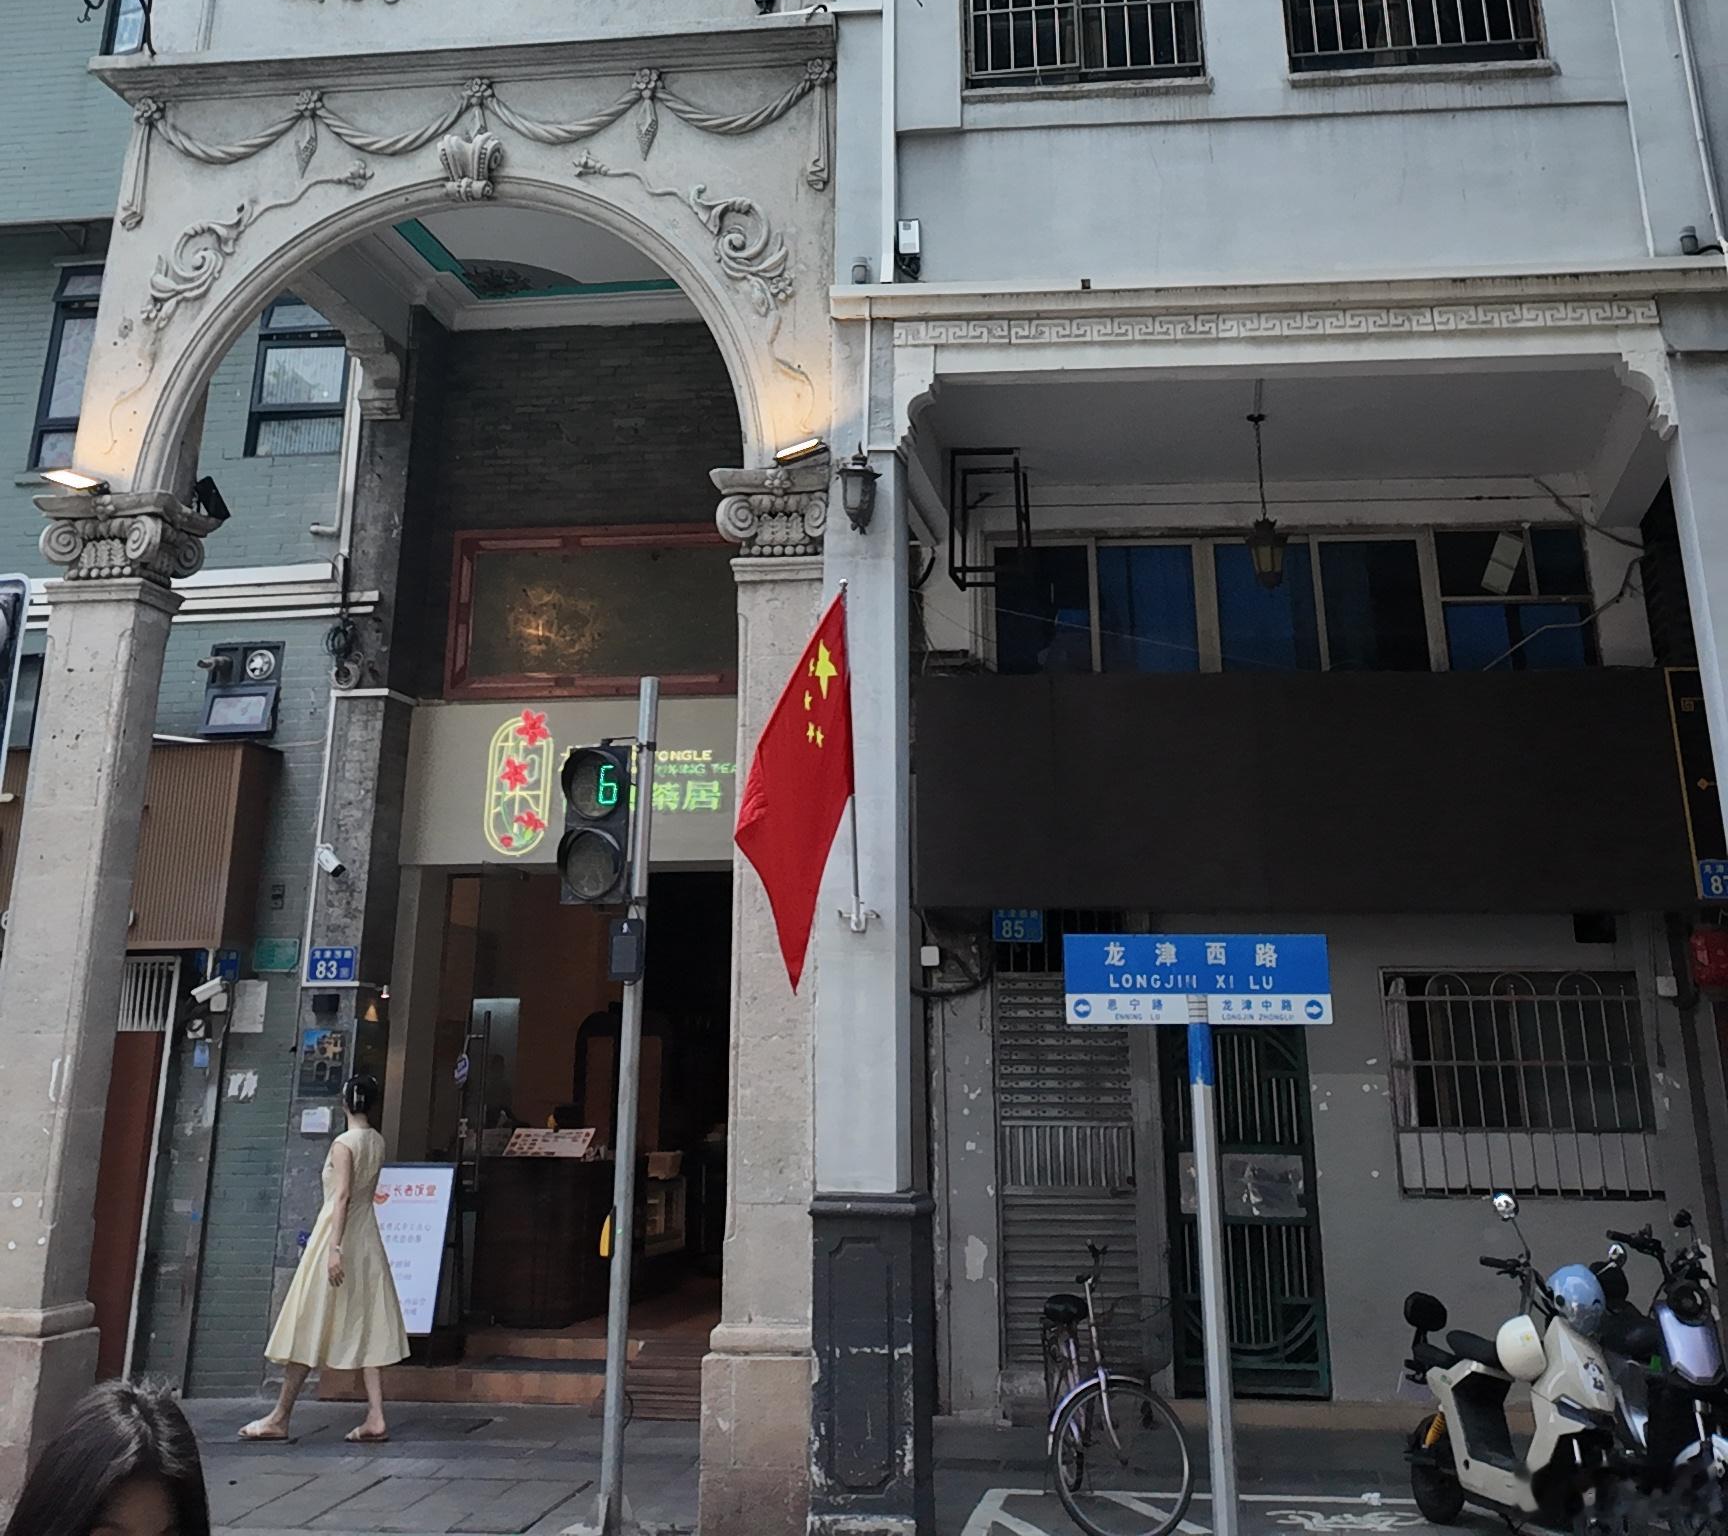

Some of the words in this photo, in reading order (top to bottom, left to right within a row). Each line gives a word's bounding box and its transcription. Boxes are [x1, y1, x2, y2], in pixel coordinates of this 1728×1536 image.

[599, 765, 617, 804] 6
[1002, 919, 1024, 938] 85
[1104, 941, 1278, 968] 龙津西路
[316, 960, 337, 979] 83
[1109, 973, 1197, 989] LONGJIN
[1216, 975, 1234, 989] XI
[1249, 975, 1274, 990] LU
[1107, 998, 1163, 1011] 恩宁路
[1222, 999, 1292, 1012] 龙津中路
[1115, 1013, 1143, 1021] ENNING
[1150, 1013, 1161, 1021] LU
[1221, 1013, 1254, 1021] LONGJIN
